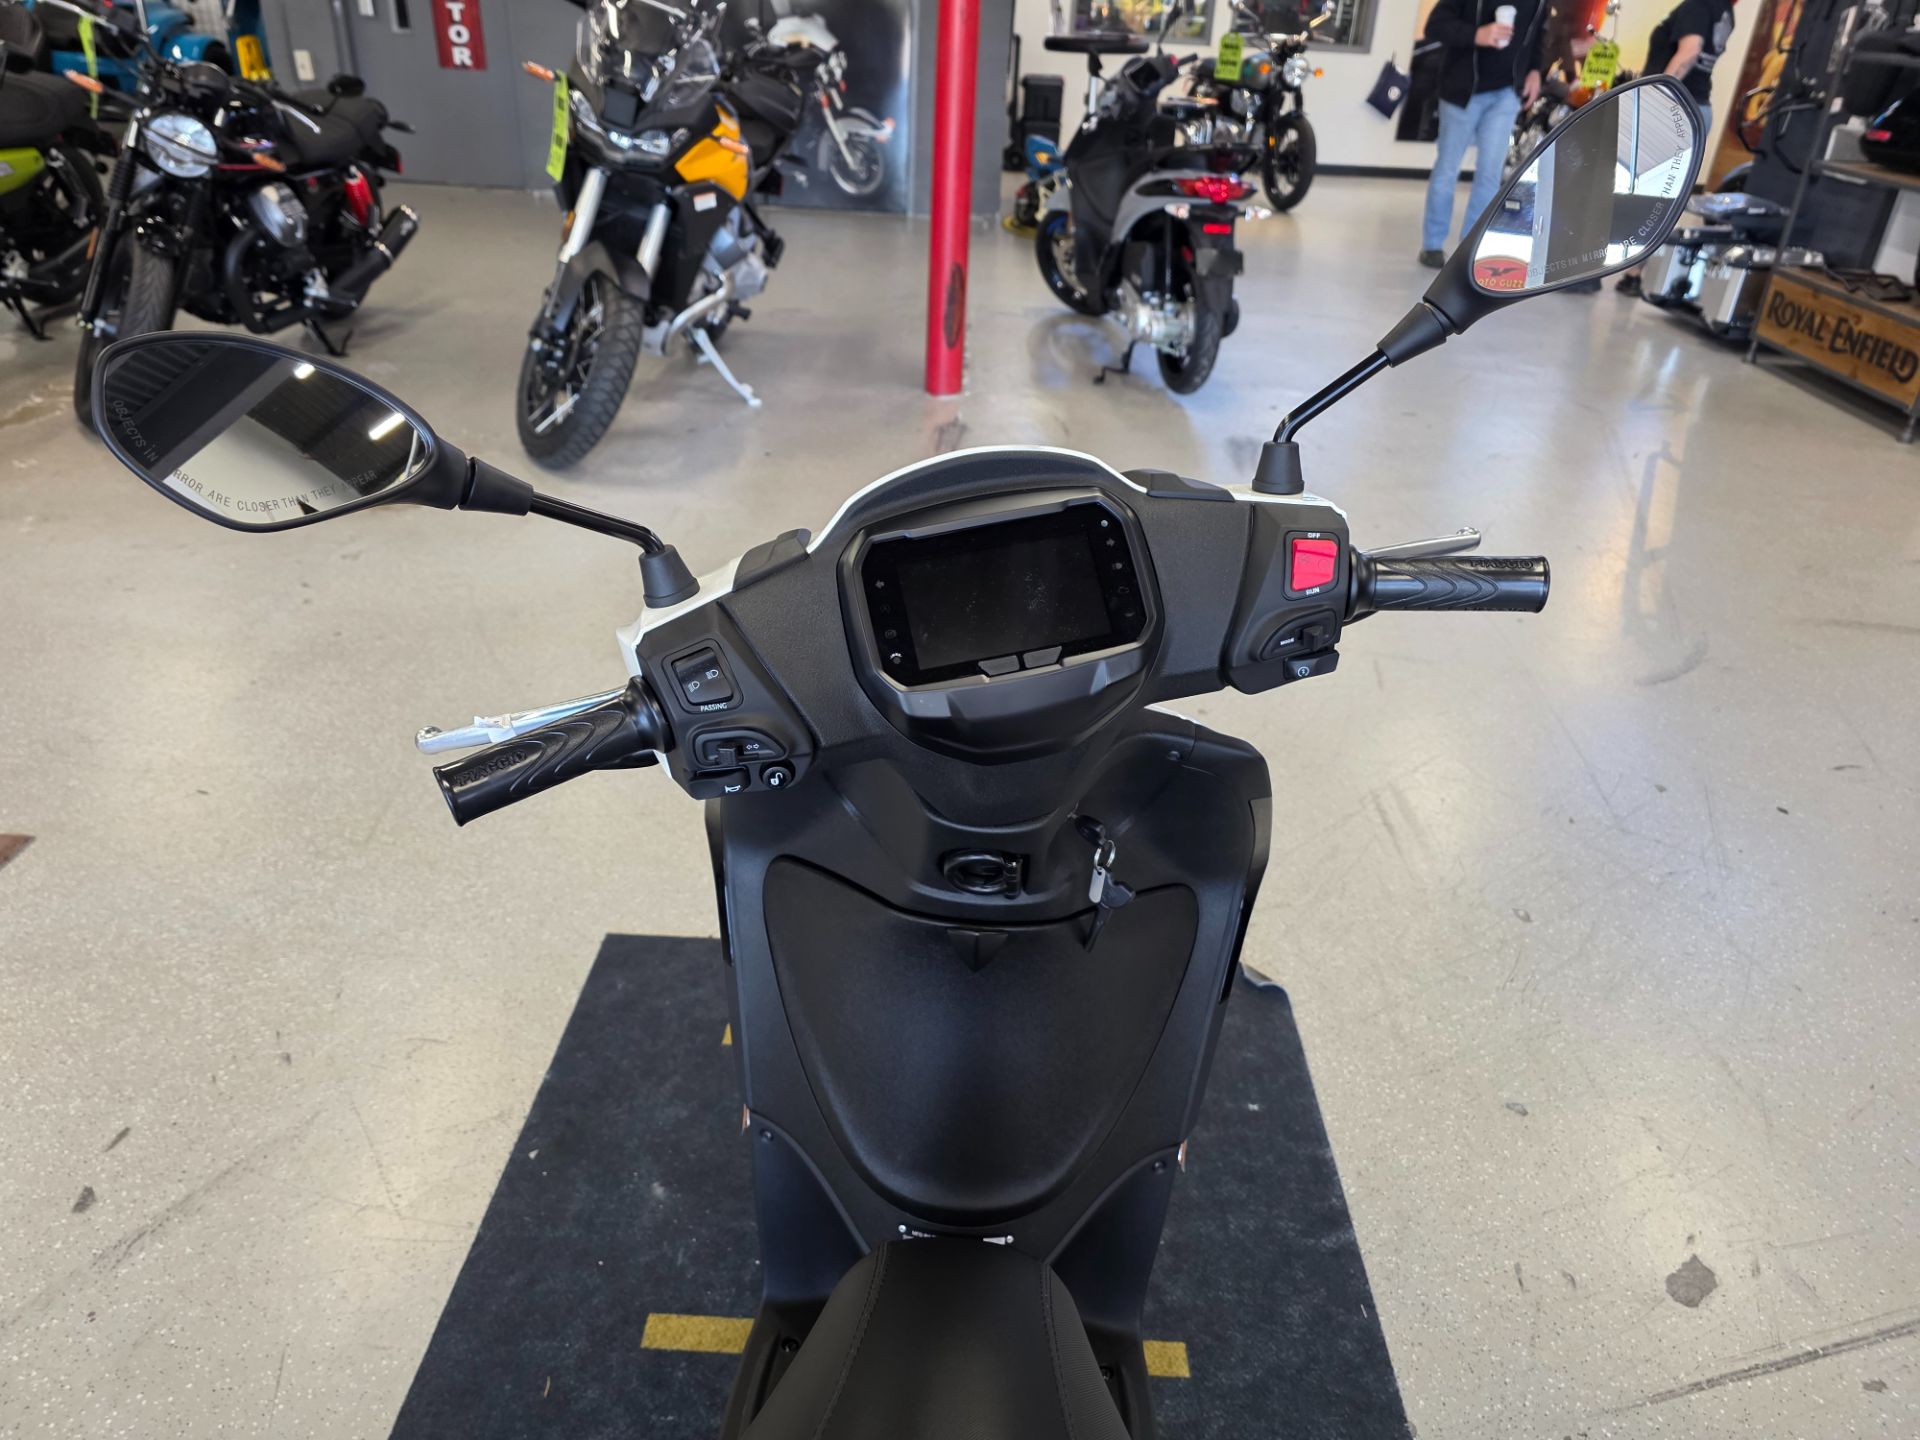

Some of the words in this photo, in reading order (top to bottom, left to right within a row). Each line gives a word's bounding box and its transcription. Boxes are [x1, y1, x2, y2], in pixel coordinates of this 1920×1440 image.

[1670, 104, 1685, 138] APPEAR
[1671, 145, 1685, 173] THEY
[1661, 174, 1676, 200] THAN
[1638, 201, 1664, 236] CLOSER
[1567, 256, 1579, 267] IN
[1499, 279, 1523, 288] GUZZ
[1768, 289, 1826, 342] ROYAL
[1828, 315, 1919, 383] ENFIELD
[113, 399, 147, 448] OBJECTS
[207, 489, 232, 508] ARE
[237, 499, 283, 513] CLOSER
[281, 496, 309, 508] THAN
[310, 484, 337, 500] THEY
[1470, 559, 1534, 569] PIAGGIO
[1305, 586, 1320, 596] RUN
[1280, 637, 1295, 646] MODE
[700, 702, 728, 712] PASSING
[454, 749, 528, 786] PIAGGIO
